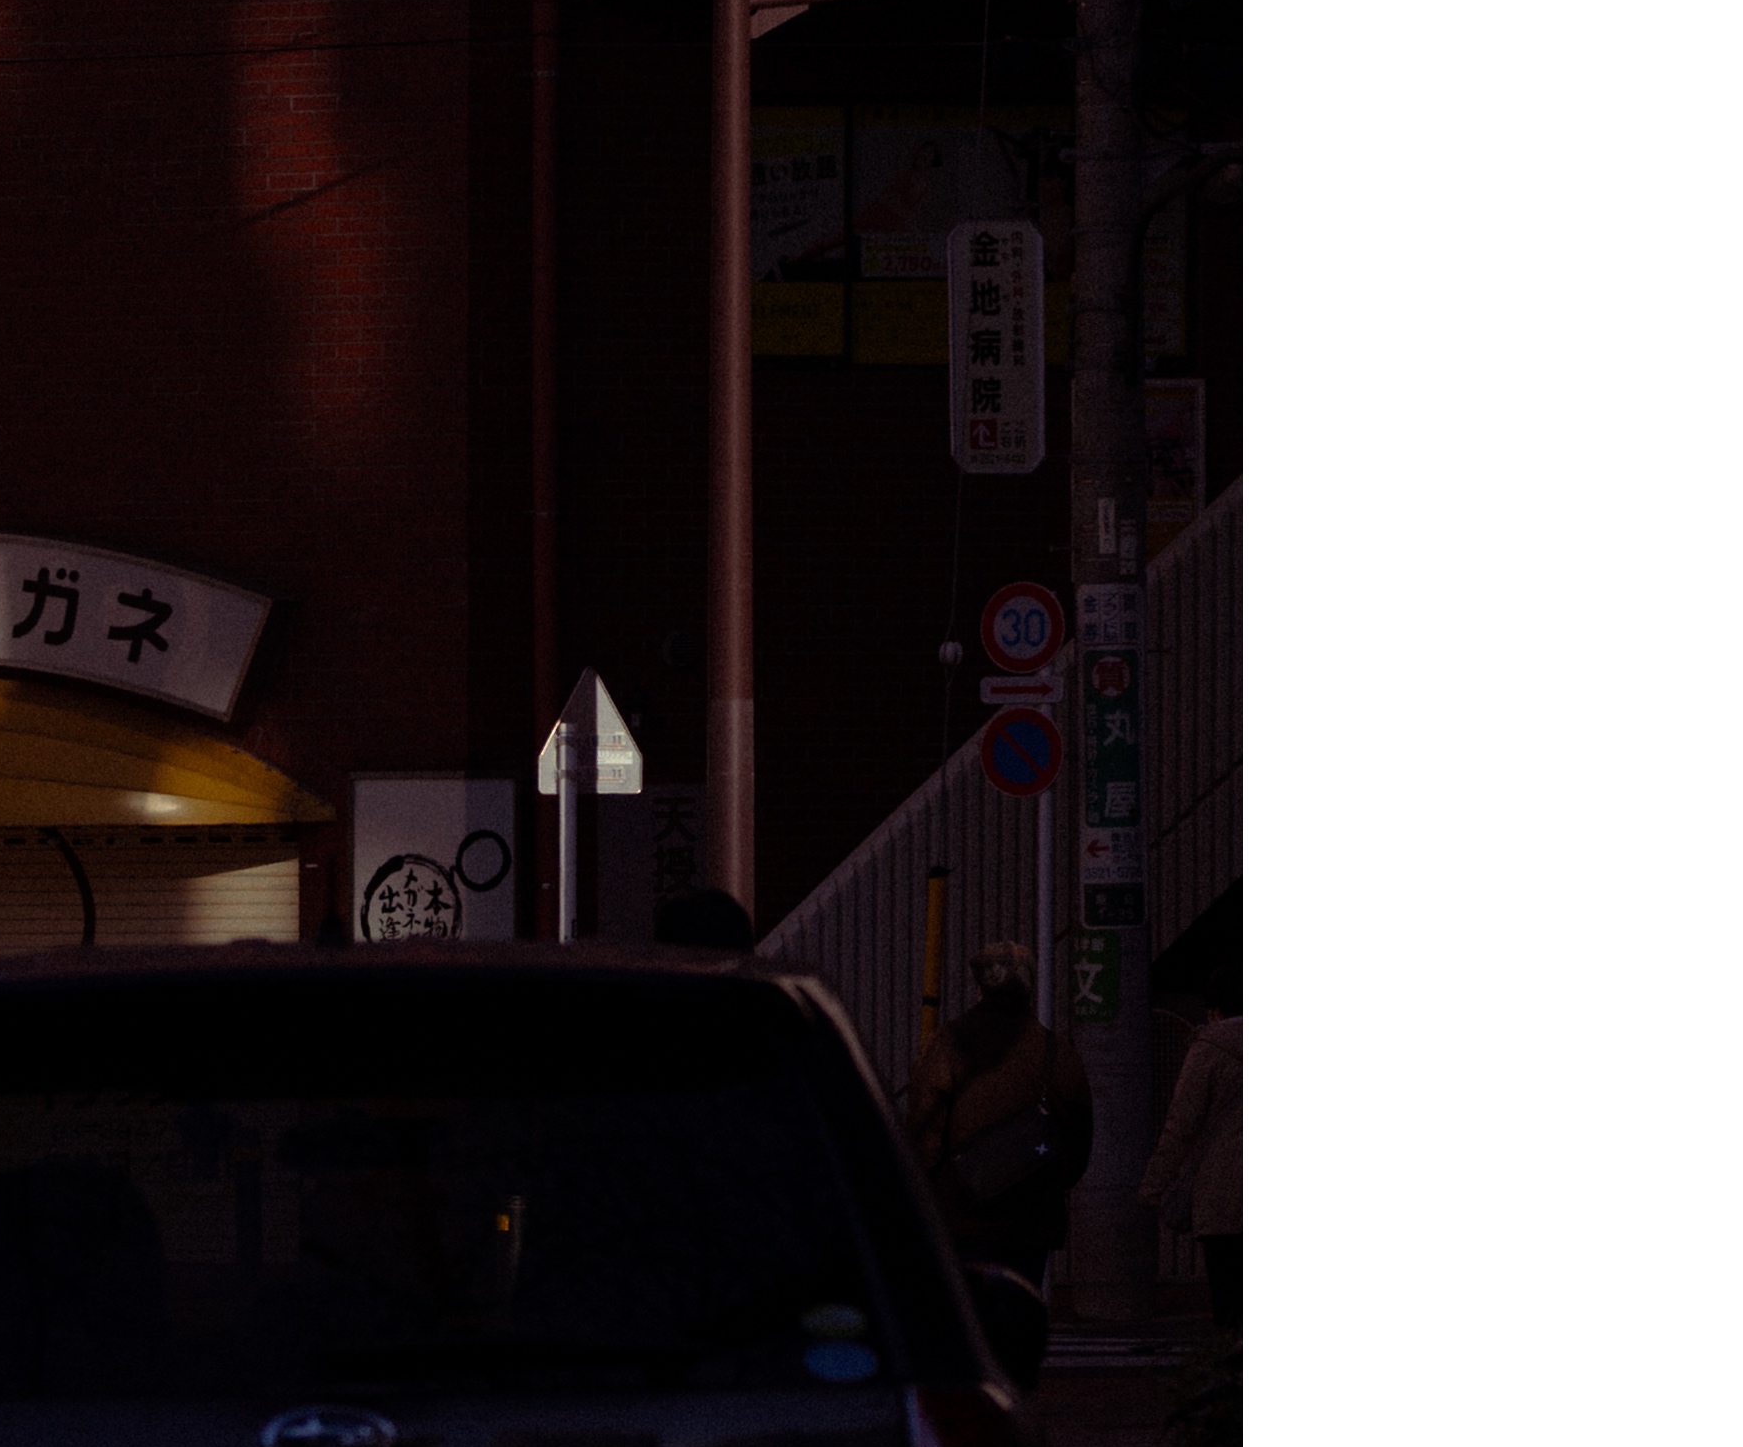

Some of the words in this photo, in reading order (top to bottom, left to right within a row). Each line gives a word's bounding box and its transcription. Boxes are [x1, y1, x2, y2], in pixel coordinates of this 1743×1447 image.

[970, 230, 1001, 415] 金地病院
[1000, 608, 1047, 648] 30
[1102, 708, 1137, 818] 丸屋
[1073, 956, 1104, 1004] 文
